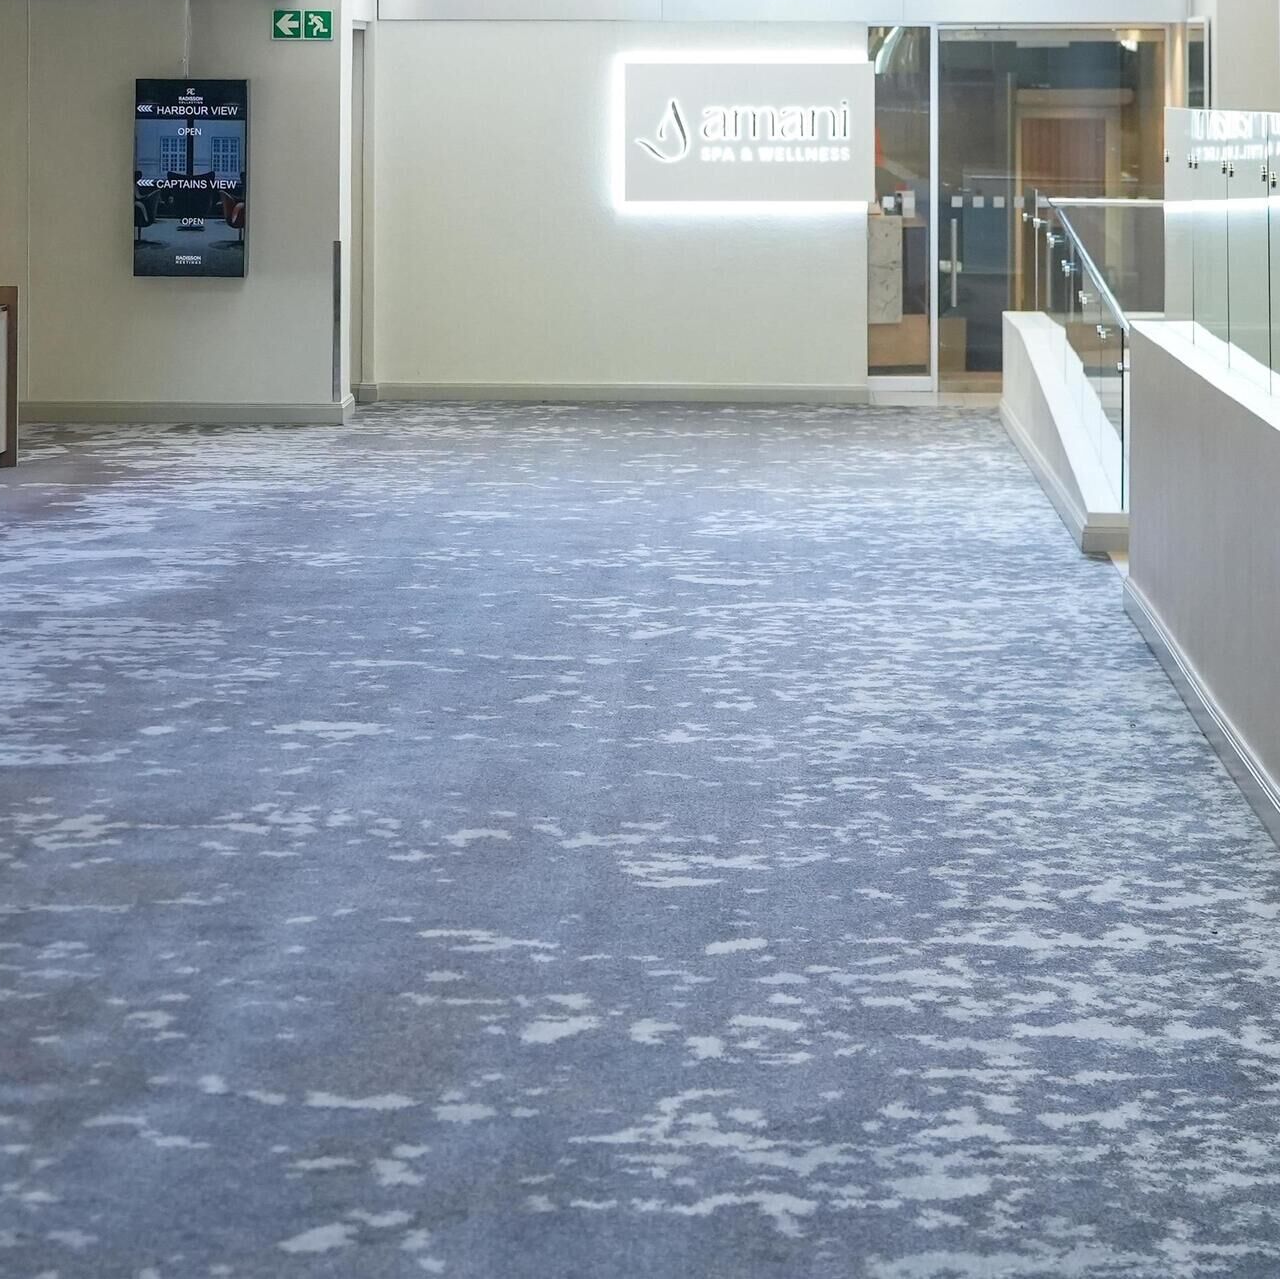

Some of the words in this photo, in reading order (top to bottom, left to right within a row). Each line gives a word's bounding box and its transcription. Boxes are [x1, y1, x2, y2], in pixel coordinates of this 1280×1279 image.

[156, 105, 208, 115] HARBOUR
[210, 106, 238, 115] VIEW
[702, 100, 850, 139] amani
[177, 127, 202, 136] OPEN
[701, 147, 735, 161] SPA
[740, 147, 753, 161] &
[758, 147, 850, 161] WELLNESS
[156, 179, 207, 189] CAPTAINS
[209, 180, 237, 189] VIEW
[181, 217, 204, 225] OPEN
